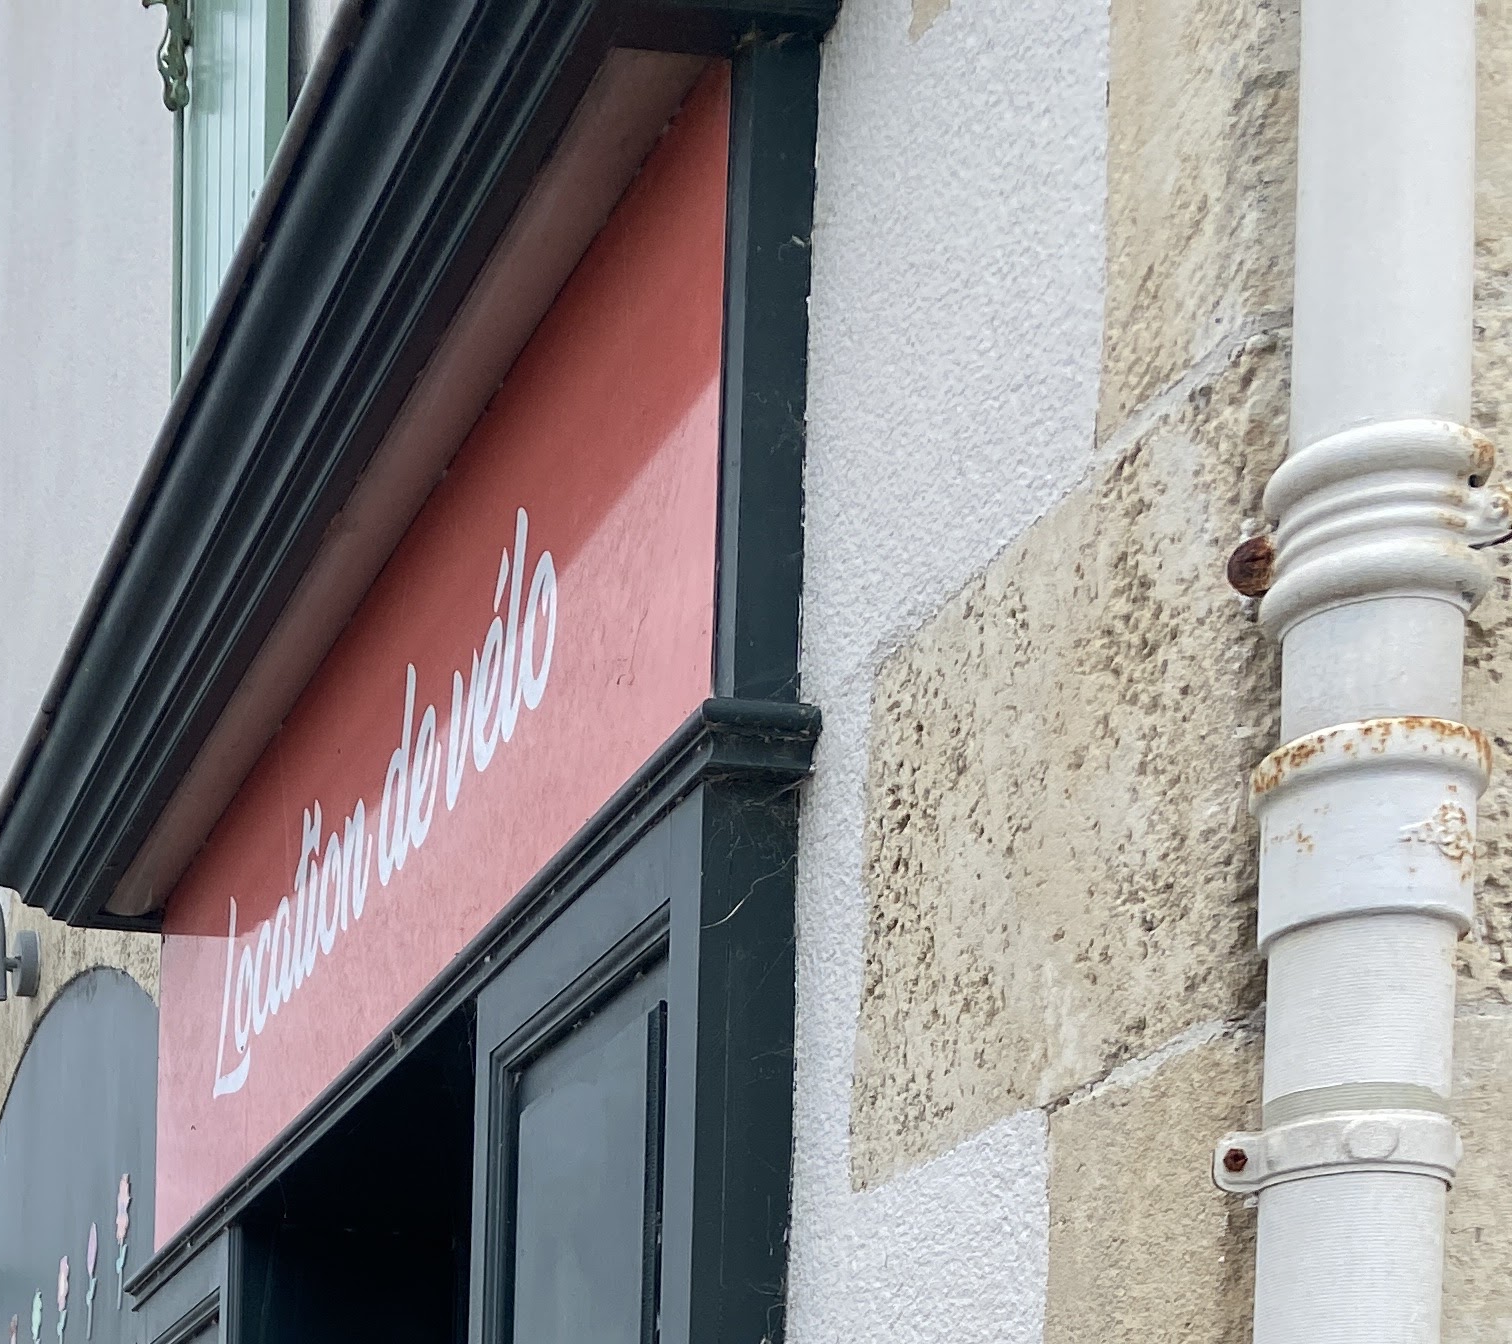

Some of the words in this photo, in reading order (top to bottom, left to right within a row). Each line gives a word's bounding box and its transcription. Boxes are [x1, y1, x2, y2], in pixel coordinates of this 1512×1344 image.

[213, 798, 372, 1099] Location
[378, 662, 441, 887] de
[446, 506, 557, 811] vélo
